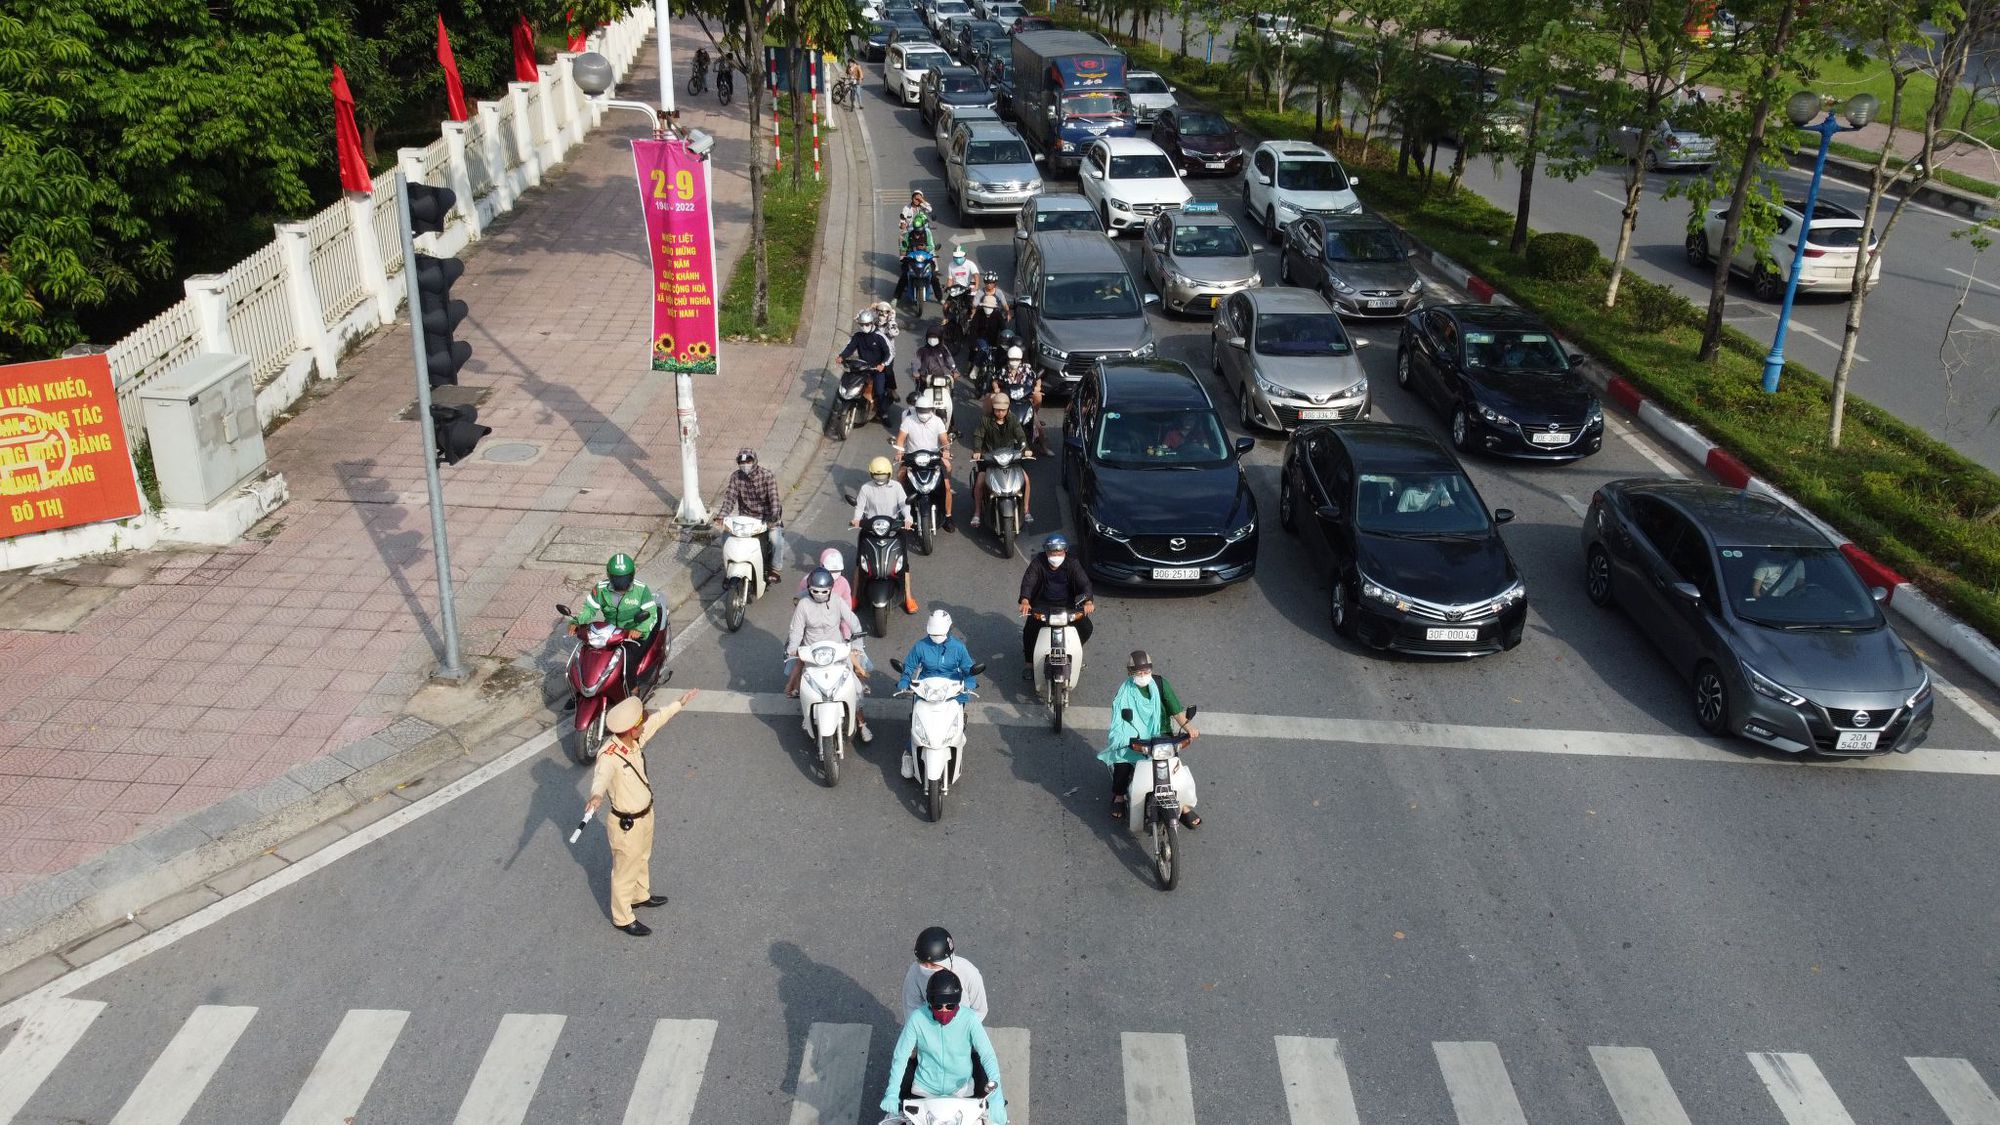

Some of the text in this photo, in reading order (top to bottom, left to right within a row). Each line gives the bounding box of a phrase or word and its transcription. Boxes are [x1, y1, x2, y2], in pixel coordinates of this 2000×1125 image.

[650, 169, 694, 200] 2-9
[675, 202, 696, 212] 2022
[43, 376, 93, 402] KHÉO,
[72, 404, 104, 427] TÁC
[70, 430, 113, 457] BẰNG
[10, 498, 65, 524] ĐÔ THỊ
